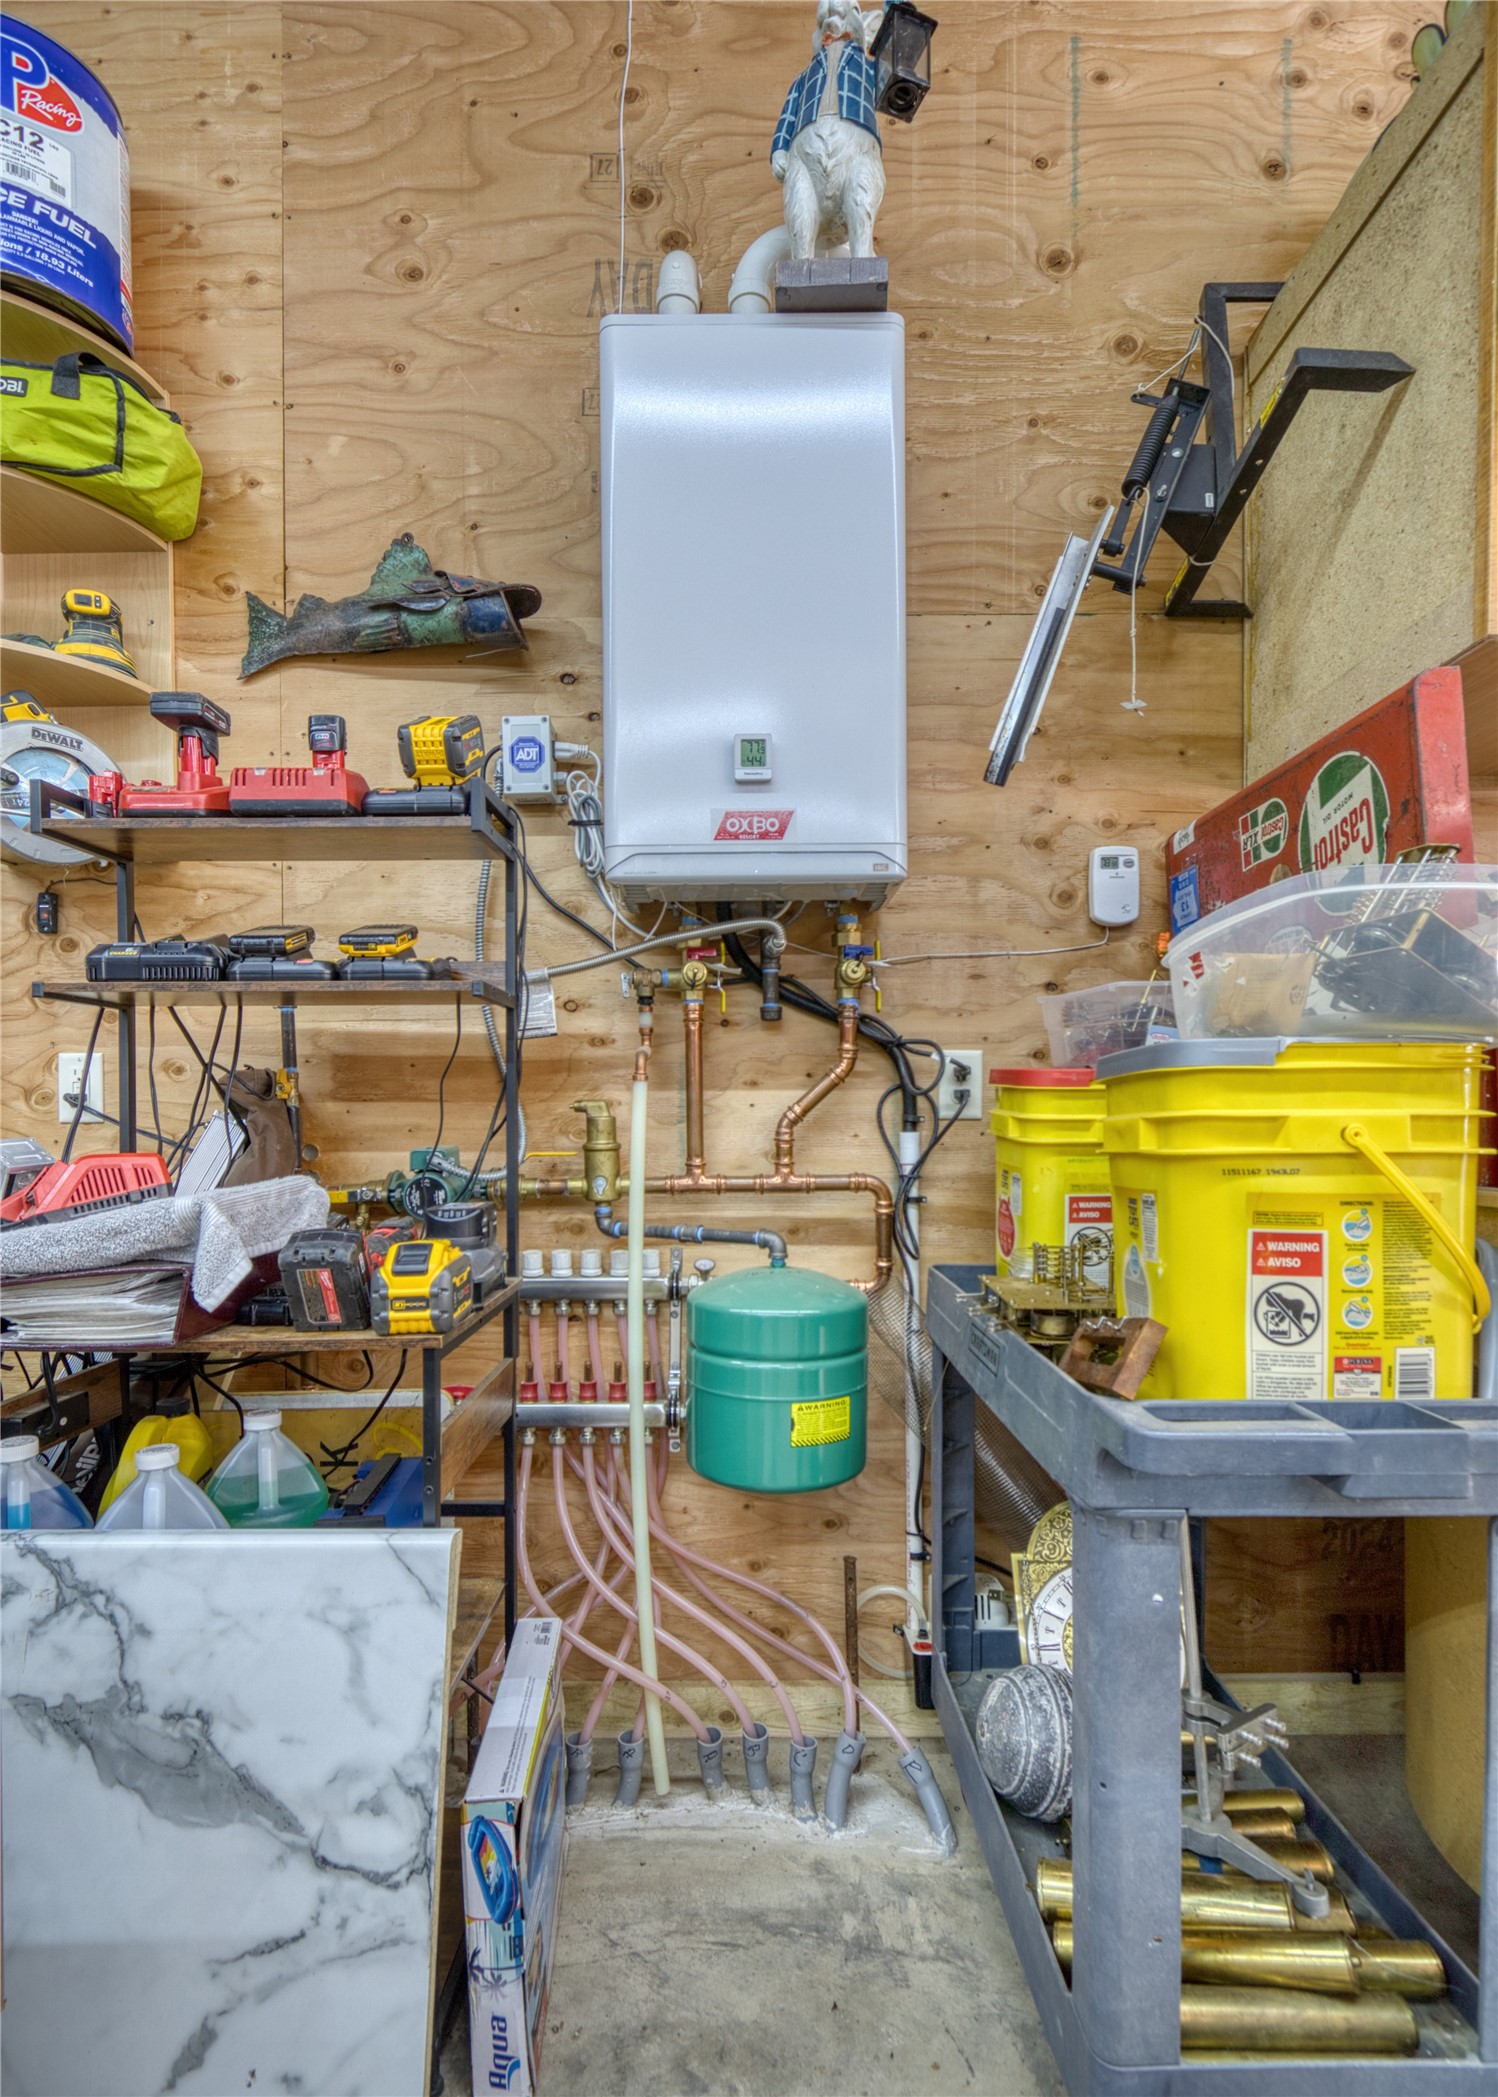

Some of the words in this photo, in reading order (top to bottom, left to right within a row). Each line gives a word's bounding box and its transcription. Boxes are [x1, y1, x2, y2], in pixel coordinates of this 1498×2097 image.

[21, 89, 82, 127] Racing
[0, 119, 44, 152] C12
[0, 137, 22, 149] ACING
[24, 145, 41, 157] FUEL
[0, 186, 28, 209] CE
[33, 200, 97, 249] FUEL
[12, 210, 38, 225] DANGER!
[0, 212, 33, 229] LAMMABLE
[33, 222, 53, 238] LIQUID
[54, 232, 66, 244] AND
[35, 250, 65, 269] 18.93
[67, 266, 94, 288] Liters
[31, 728, 83, 750] DEWALT
[515, 748, 539, 761] ADT
[747, 756, 762, 767] 44
[1333, 791, 1353, 814] MOTOR
[726, 817, 779, 834] OXBO
[1261, 816, 1284, 840] Castrol
[1322, 813, 1331, 824] OIL
[1243, 832, 1259, 851] XLR
[1314, 797, 1374, 871] Castrol
[1078, 1201, 1111, 1209] WARNING
[1267, 1241, 1320, 1252] WARNING
[1267, 1257, 1302, 1267] AVISO
[804, 1400, 846, 1411] WARNING
[489, 2013, 516, 2090] Aqua
